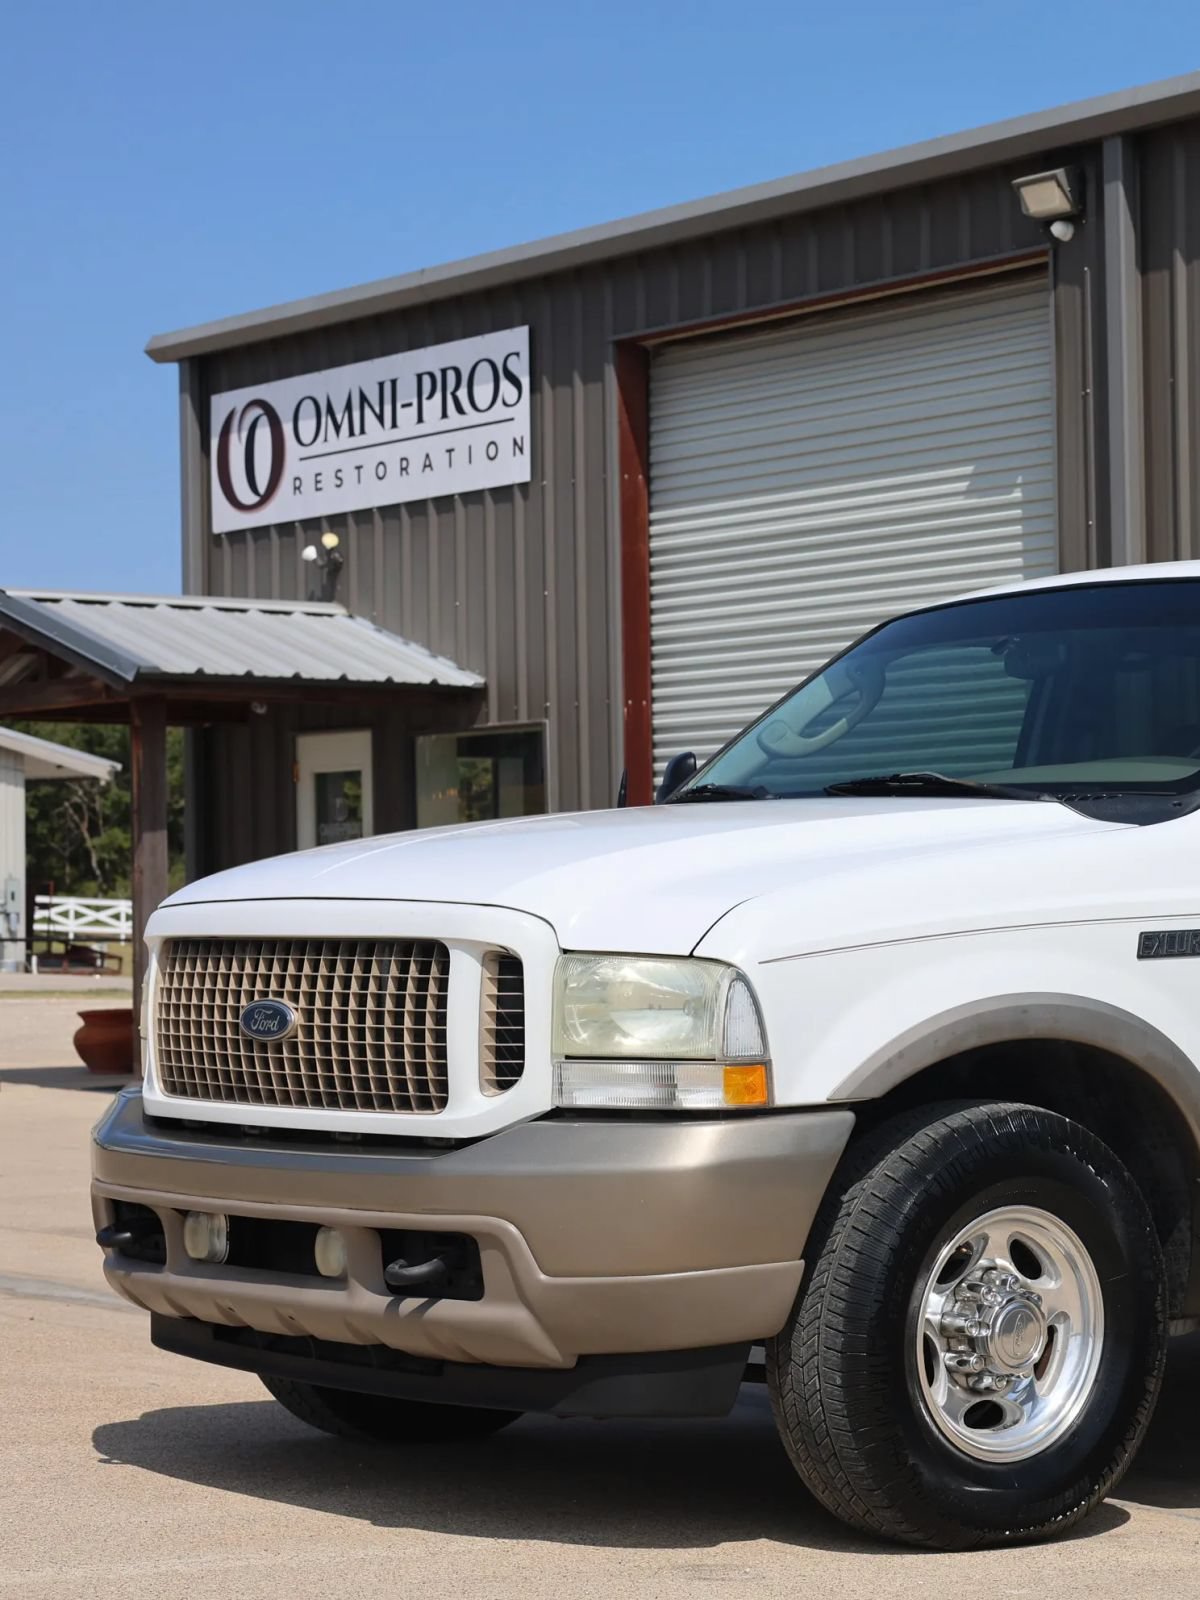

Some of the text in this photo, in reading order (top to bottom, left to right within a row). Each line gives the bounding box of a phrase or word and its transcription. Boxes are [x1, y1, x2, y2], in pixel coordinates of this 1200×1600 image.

[293, 352, 524, 448] OMNI-PROS
[293, 435, 526, 496] RESTORATION
[250, 1008, 280, 1031] Ford
